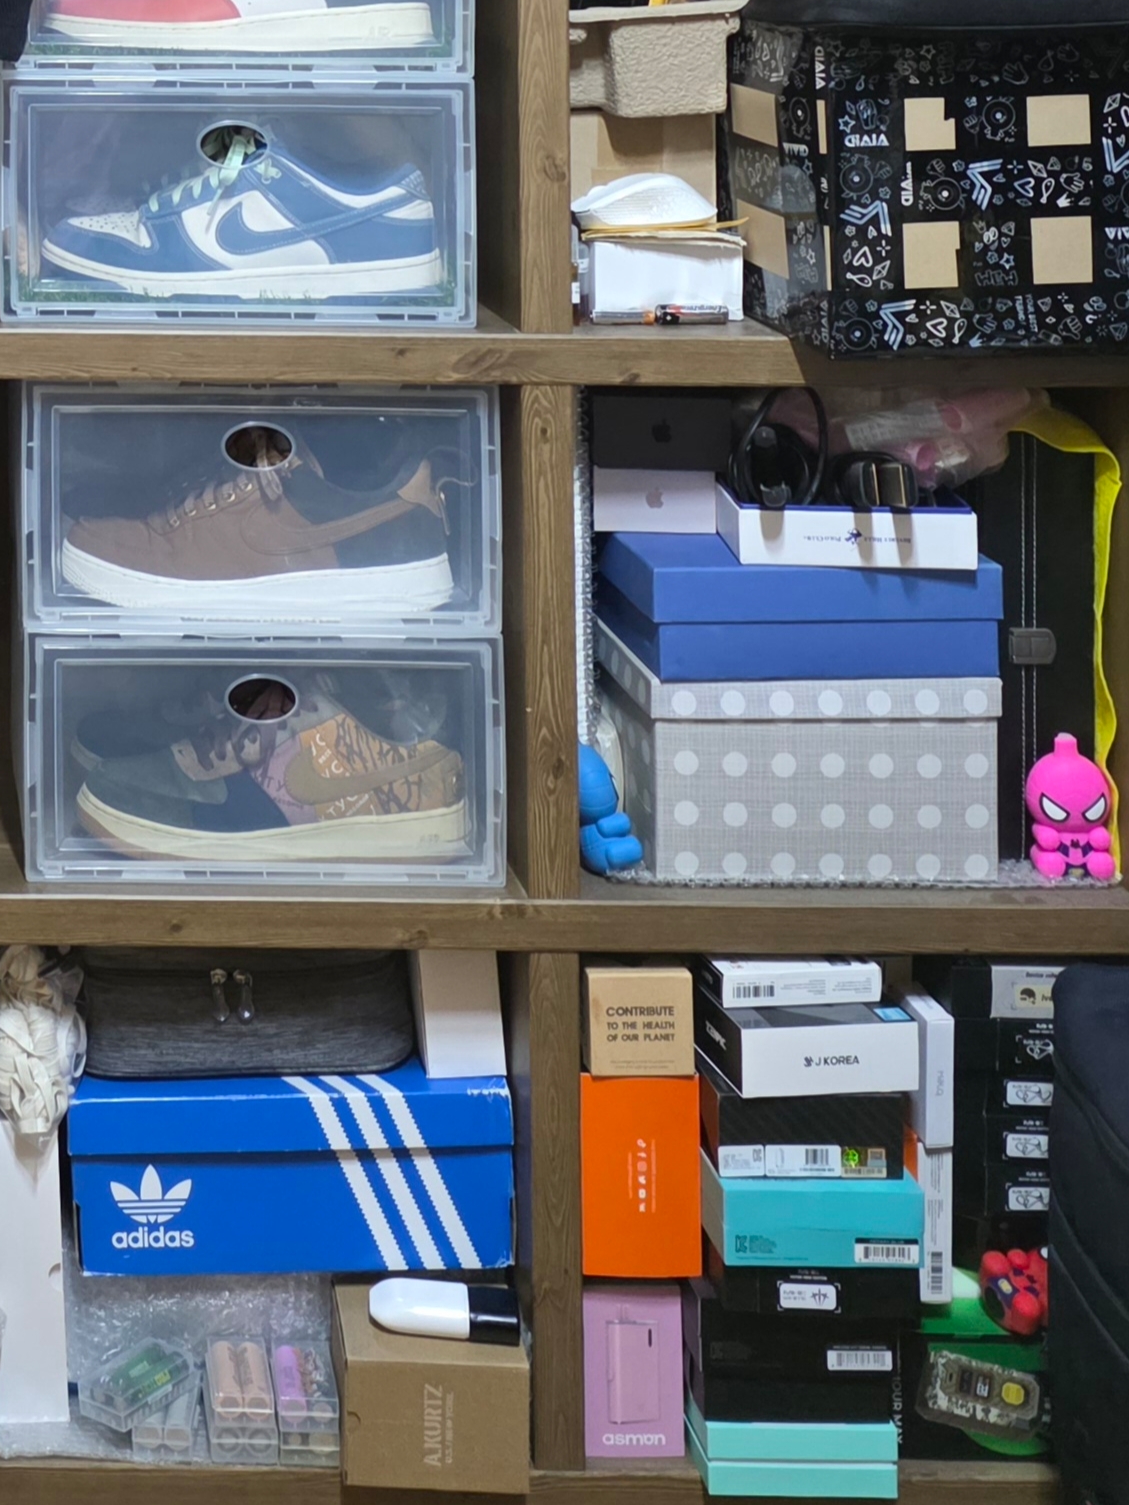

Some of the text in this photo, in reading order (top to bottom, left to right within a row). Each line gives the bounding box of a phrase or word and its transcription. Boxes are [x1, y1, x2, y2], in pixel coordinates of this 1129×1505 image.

[814, 45, 827, 91] VIVID
[844, 133, 890, 148] VIVID
[782, 141, 810, 158] VIVID
[605, 1006, 675, 1017] CONTRIBUTE
[607, 1021, 676, 1031] TO THE HEALTH
[606, 1033, 676, 1042] OF OUR PLANET
[823, 1055, 860, 1066] KOREA
[112, 1226, 195, 1249] adidas
[423, 1382, 443, 1467] A.KURTZ
